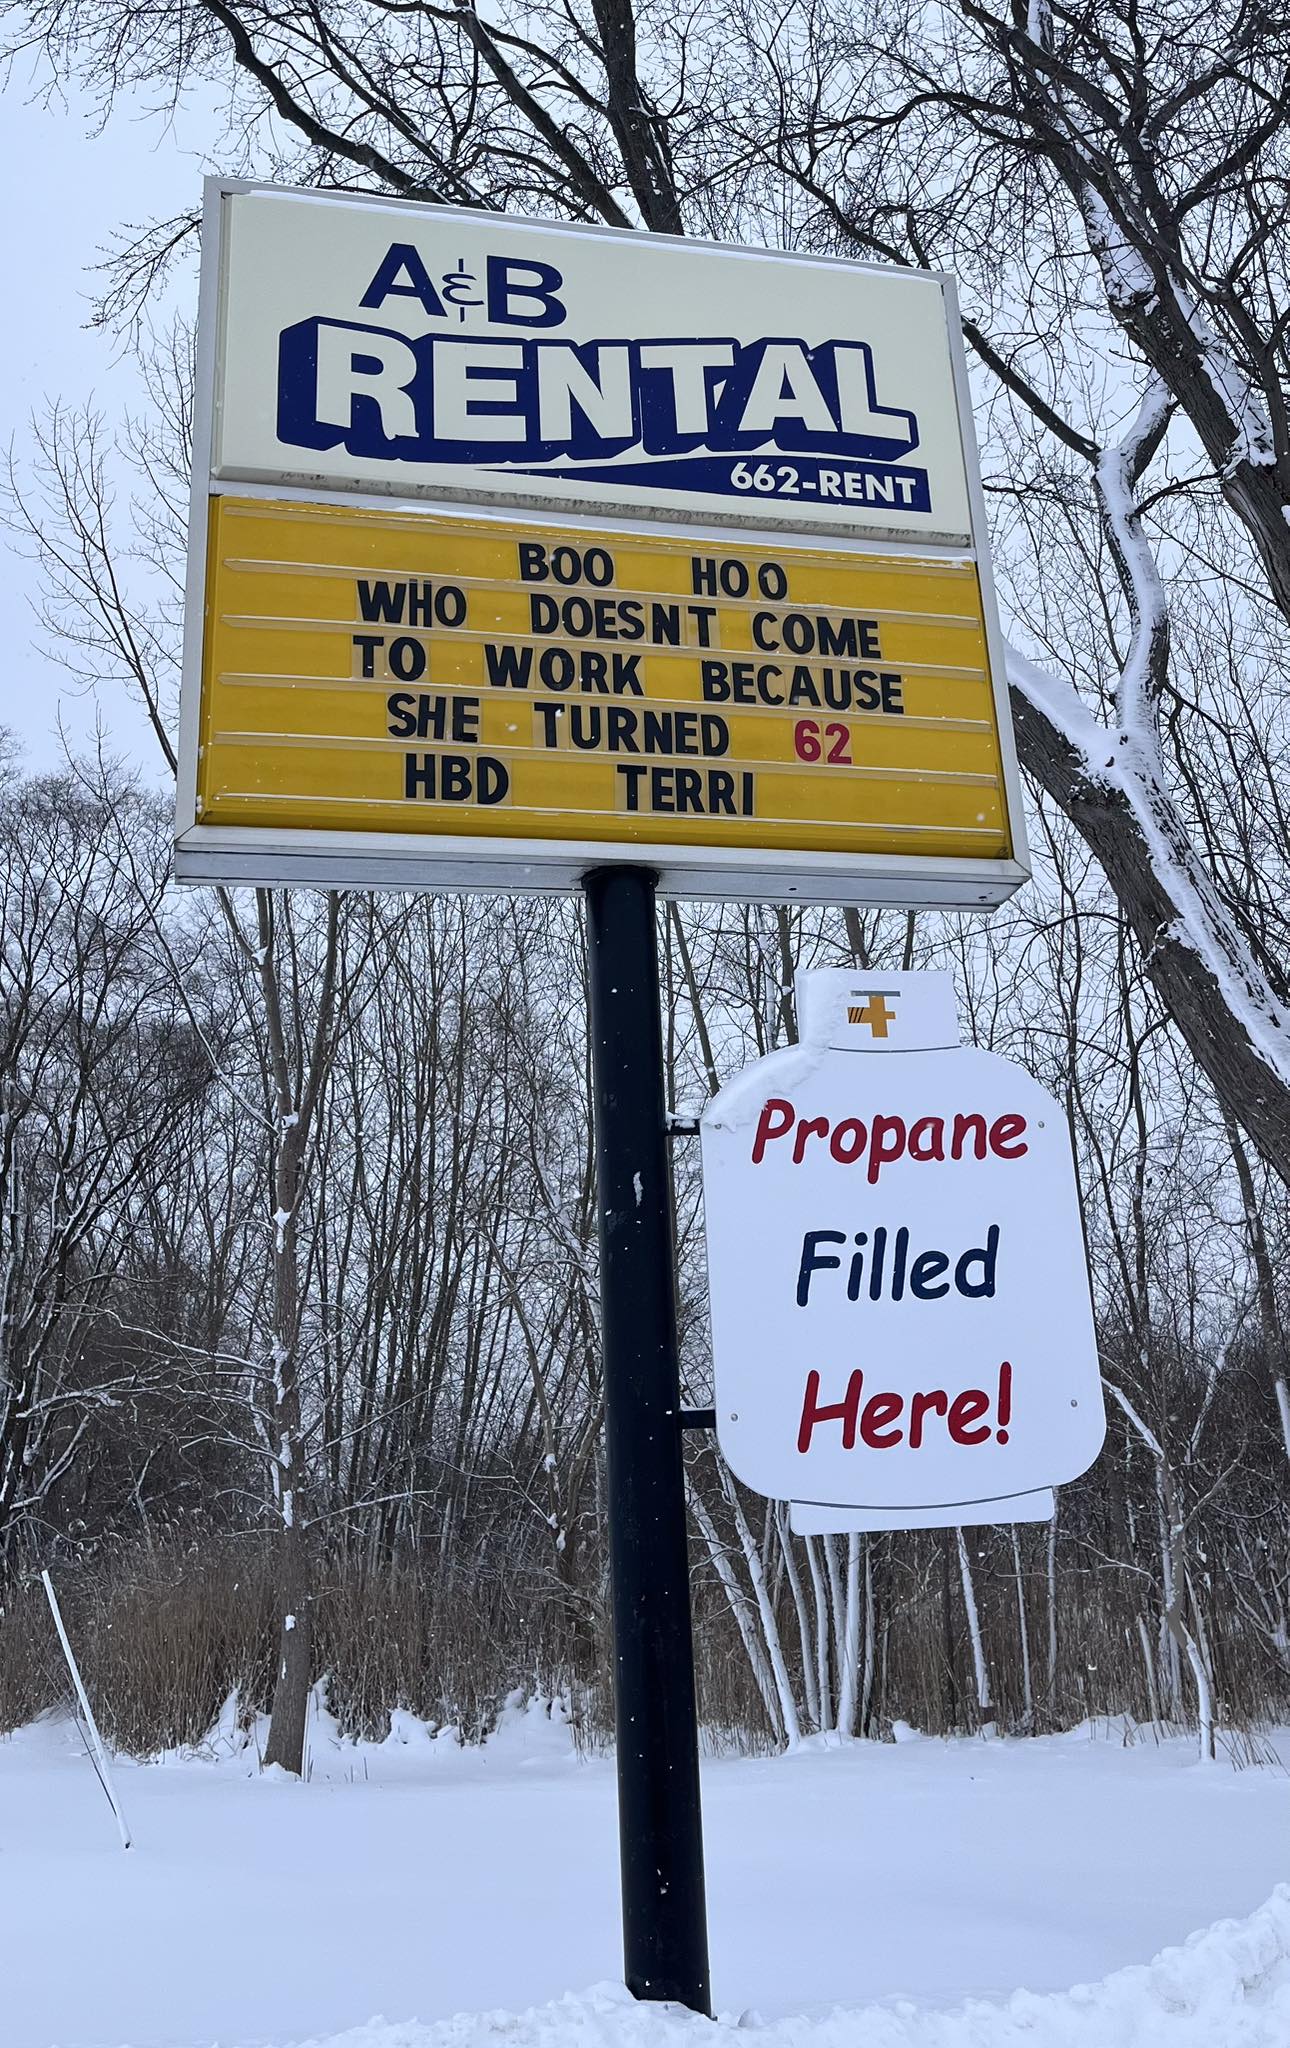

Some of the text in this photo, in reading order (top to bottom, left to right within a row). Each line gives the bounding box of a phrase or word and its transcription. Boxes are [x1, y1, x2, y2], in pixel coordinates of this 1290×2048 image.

[313, 322, 913, 444] RENTAL
[730, 461, 917, 505] 662-RENT
[519, 542, 615, 588] BOO
[357, 579, 882, 660] WHO DOESNT COME
[353, 635, 904, 714] TO WORK BECAUSE
[387, 693, 853, 765] SHE TURNED 62
[405, 753, 756, 816] HBD TERRI
[751, 1098, 1029, 1185] Propane
[796, 1224, 1000, 1307] Filled
[797, 1361, 1012, 1453] Here!
